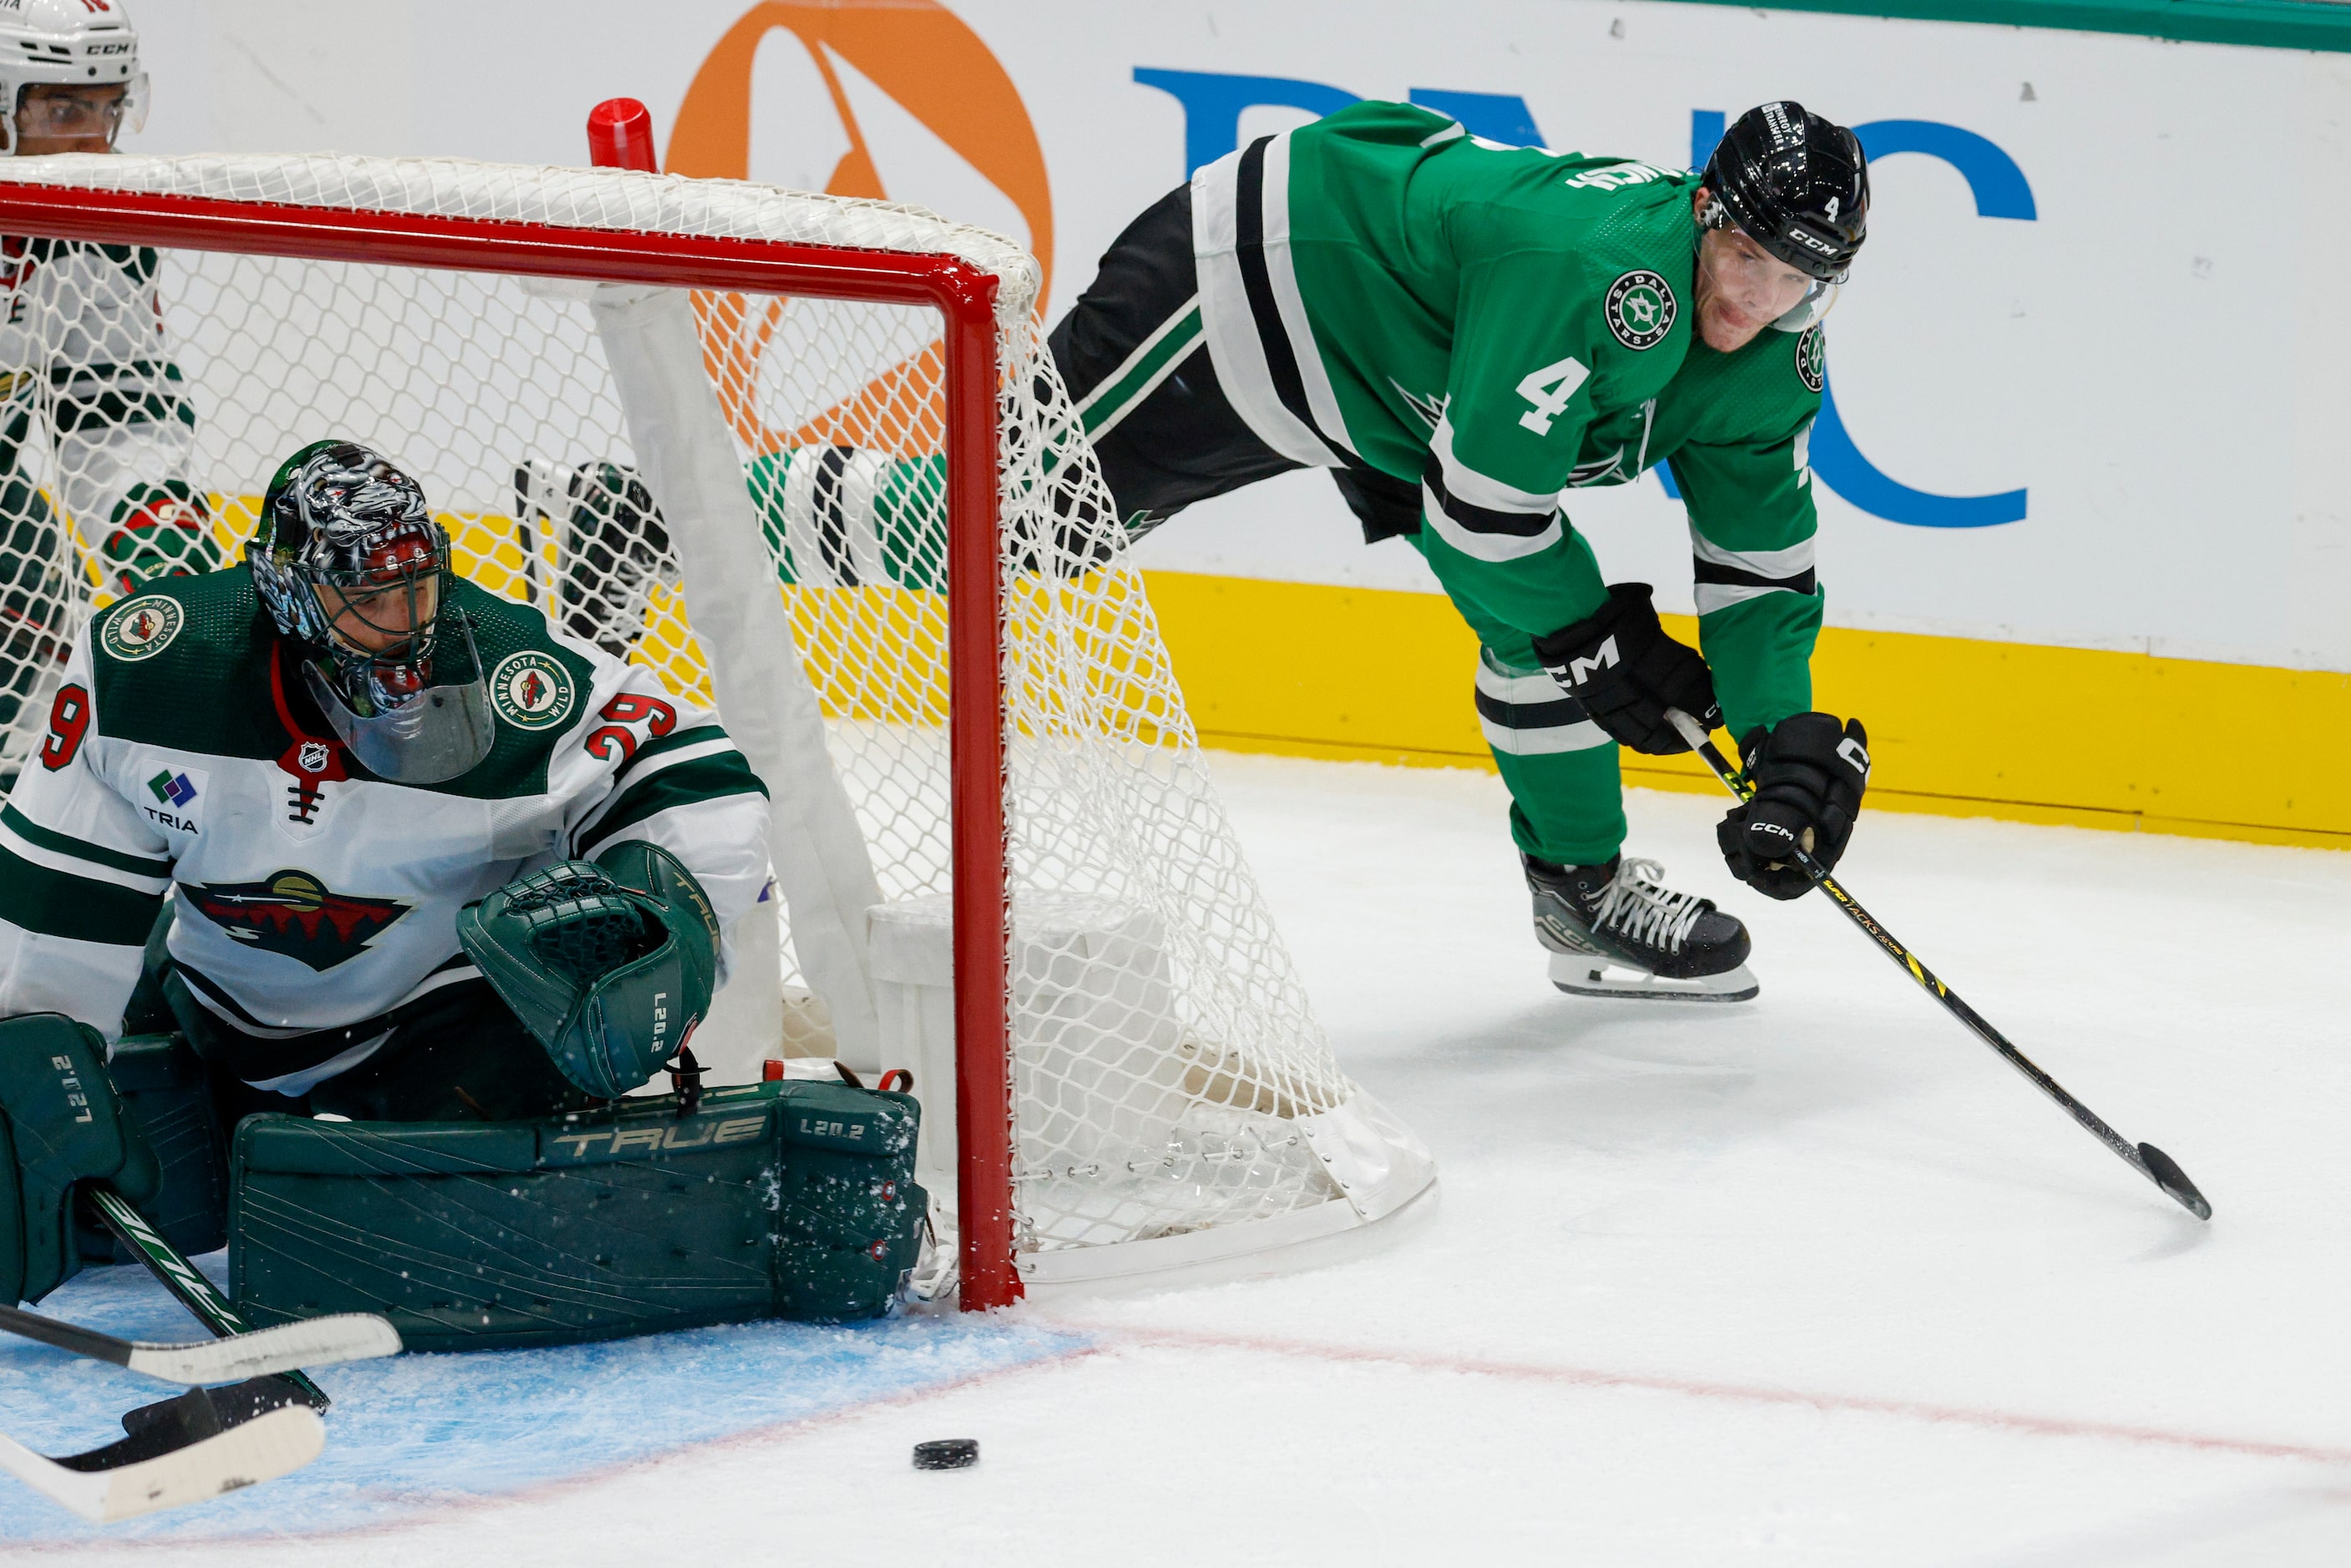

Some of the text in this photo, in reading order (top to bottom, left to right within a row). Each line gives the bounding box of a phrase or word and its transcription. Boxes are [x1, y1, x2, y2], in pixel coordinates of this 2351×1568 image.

[87, 44, 129, 55] CCM
[1764, 111, 1785, 146] TRANSFER
[1774, 109, 1792, 134] ENERGY
[1824, 196, 1839, 223] 4
[1789, 228, 1838, 255] CCM
[1610, 288, 1642, 345] STARS
[1634, 276, 1671, 336] DALLAS
[1515, 356, 1590, 437] 4
[107, 616, 124, 645] WILD
[145, 599, 177, 652] MINNESOTA
[1543, 634, 1621, 688] CM
[498, 656, 538, 717] MINNESOTA
[548, 685, 569, 718] WILD
[303, 751, 324, 766] NHL
[144, 807, 199, 835] TRIA
[1750, 822, 1795, 842] CCM
[674, 872, 721, 956] TRUE
[1823, 879, 1848, 903] SUPER
[1845, 899, 1881, 935] TACKS
[1545, 913, 1610, 956] CCM
[651, 992, 667, 1054] L20.2
[553, 1115, 766, 1157] TRUE
[801, 1118, 865, 1141] L20.2
[88, 1187, 241, 1337] RUE
